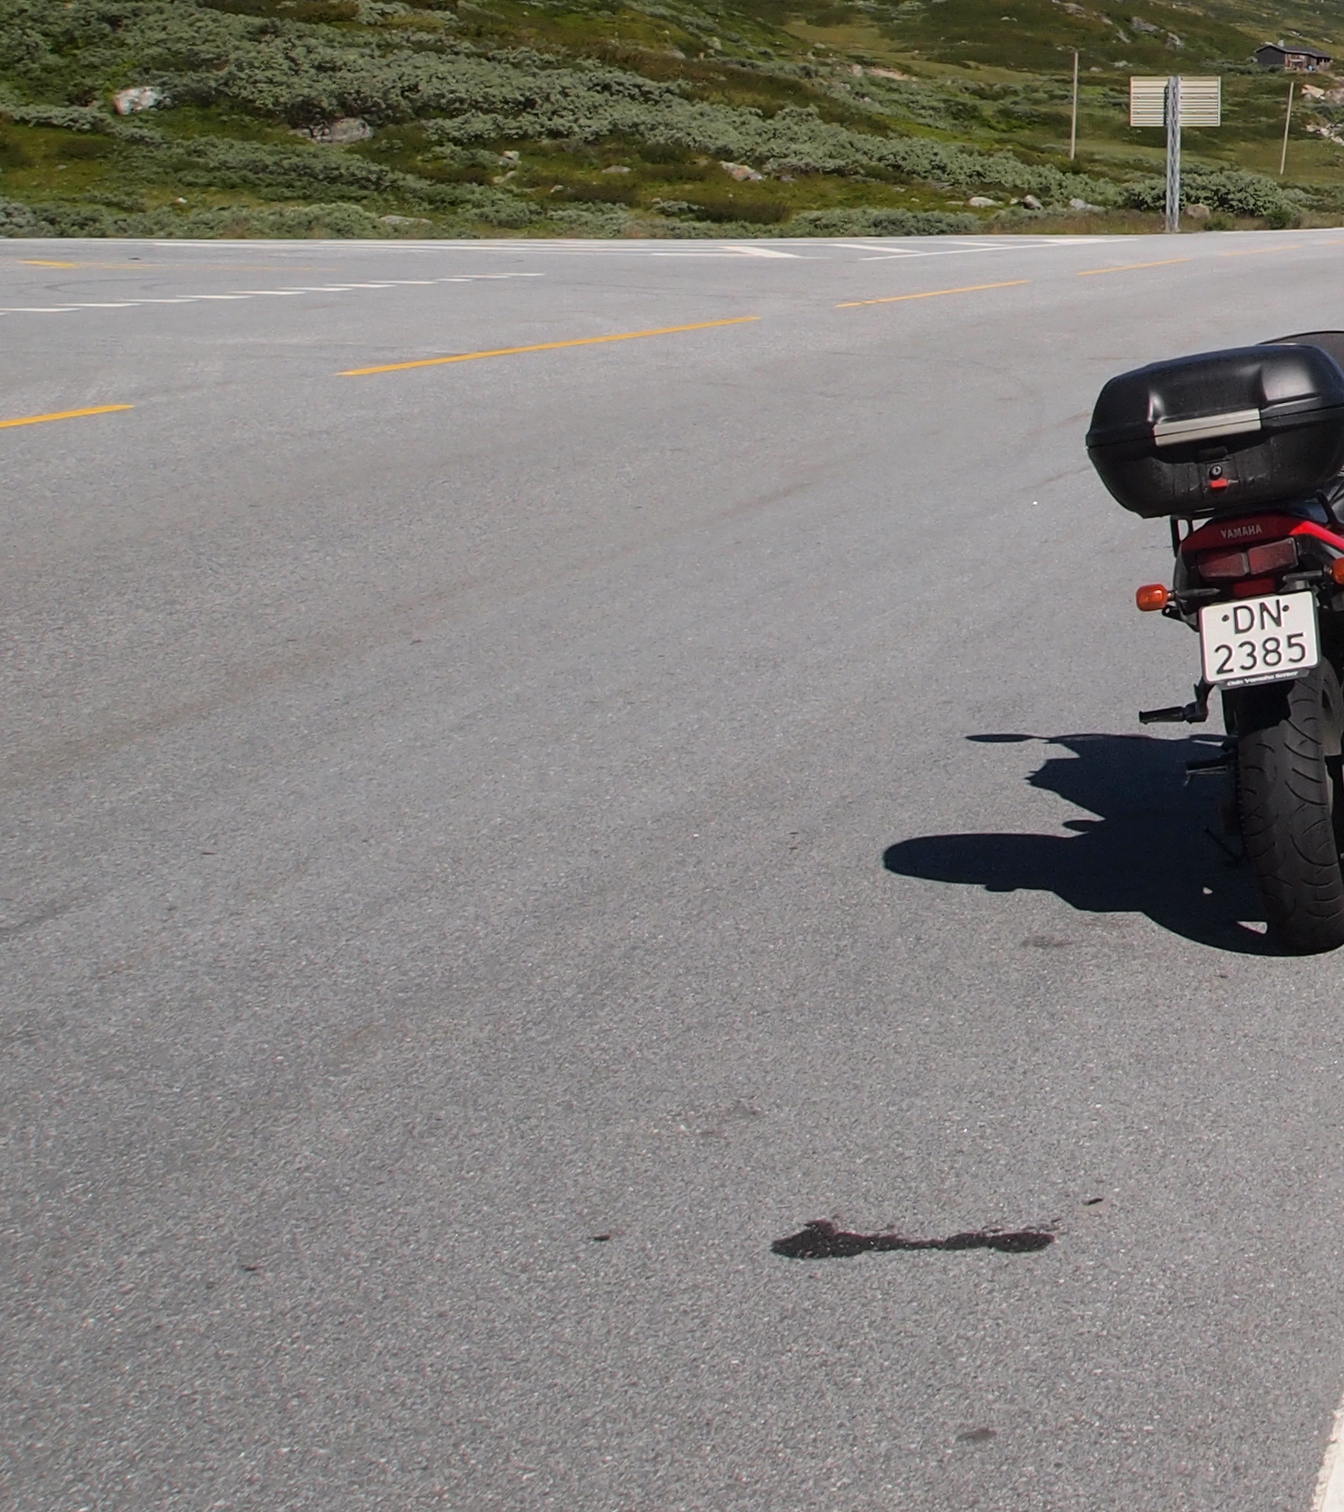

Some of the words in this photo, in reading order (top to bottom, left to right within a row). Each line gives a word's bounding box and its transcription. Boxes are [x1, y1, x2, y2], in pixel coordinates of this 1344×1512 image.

[1220, 524, 1263, 539] YAMAHA
[1232, 599, 1283, 635] DN
[1214, 632, 1307, 675] 2385
